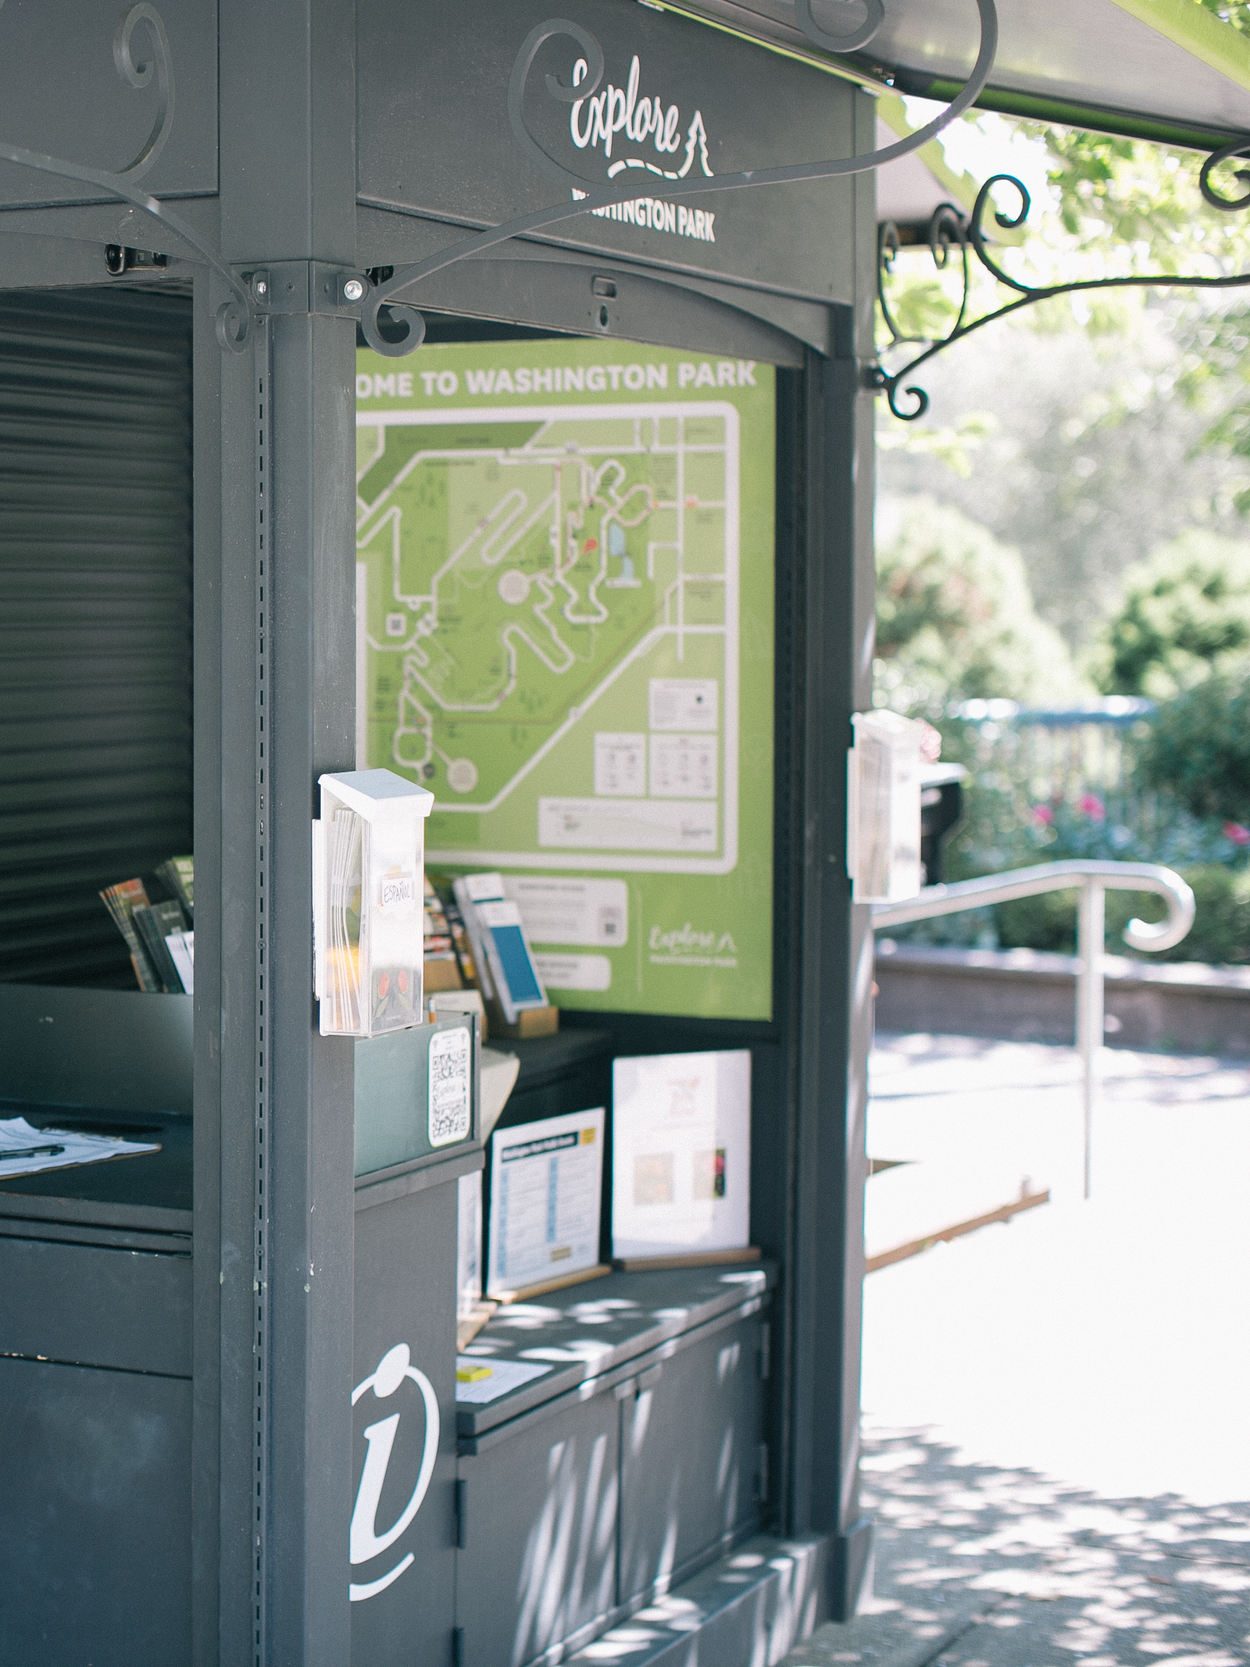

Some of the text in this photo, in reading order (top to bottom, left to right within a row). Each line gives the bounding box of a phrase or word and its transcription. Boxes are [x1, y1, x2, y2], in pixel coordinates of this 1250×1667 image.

[570, 54, 681, 158] Explore
[677, 205, 716, 243] PARK
[420, 371, 459, 397] TO
[465, 363, 669, 395] WASHINGTON
[678, 360, 758, 389] PARK
